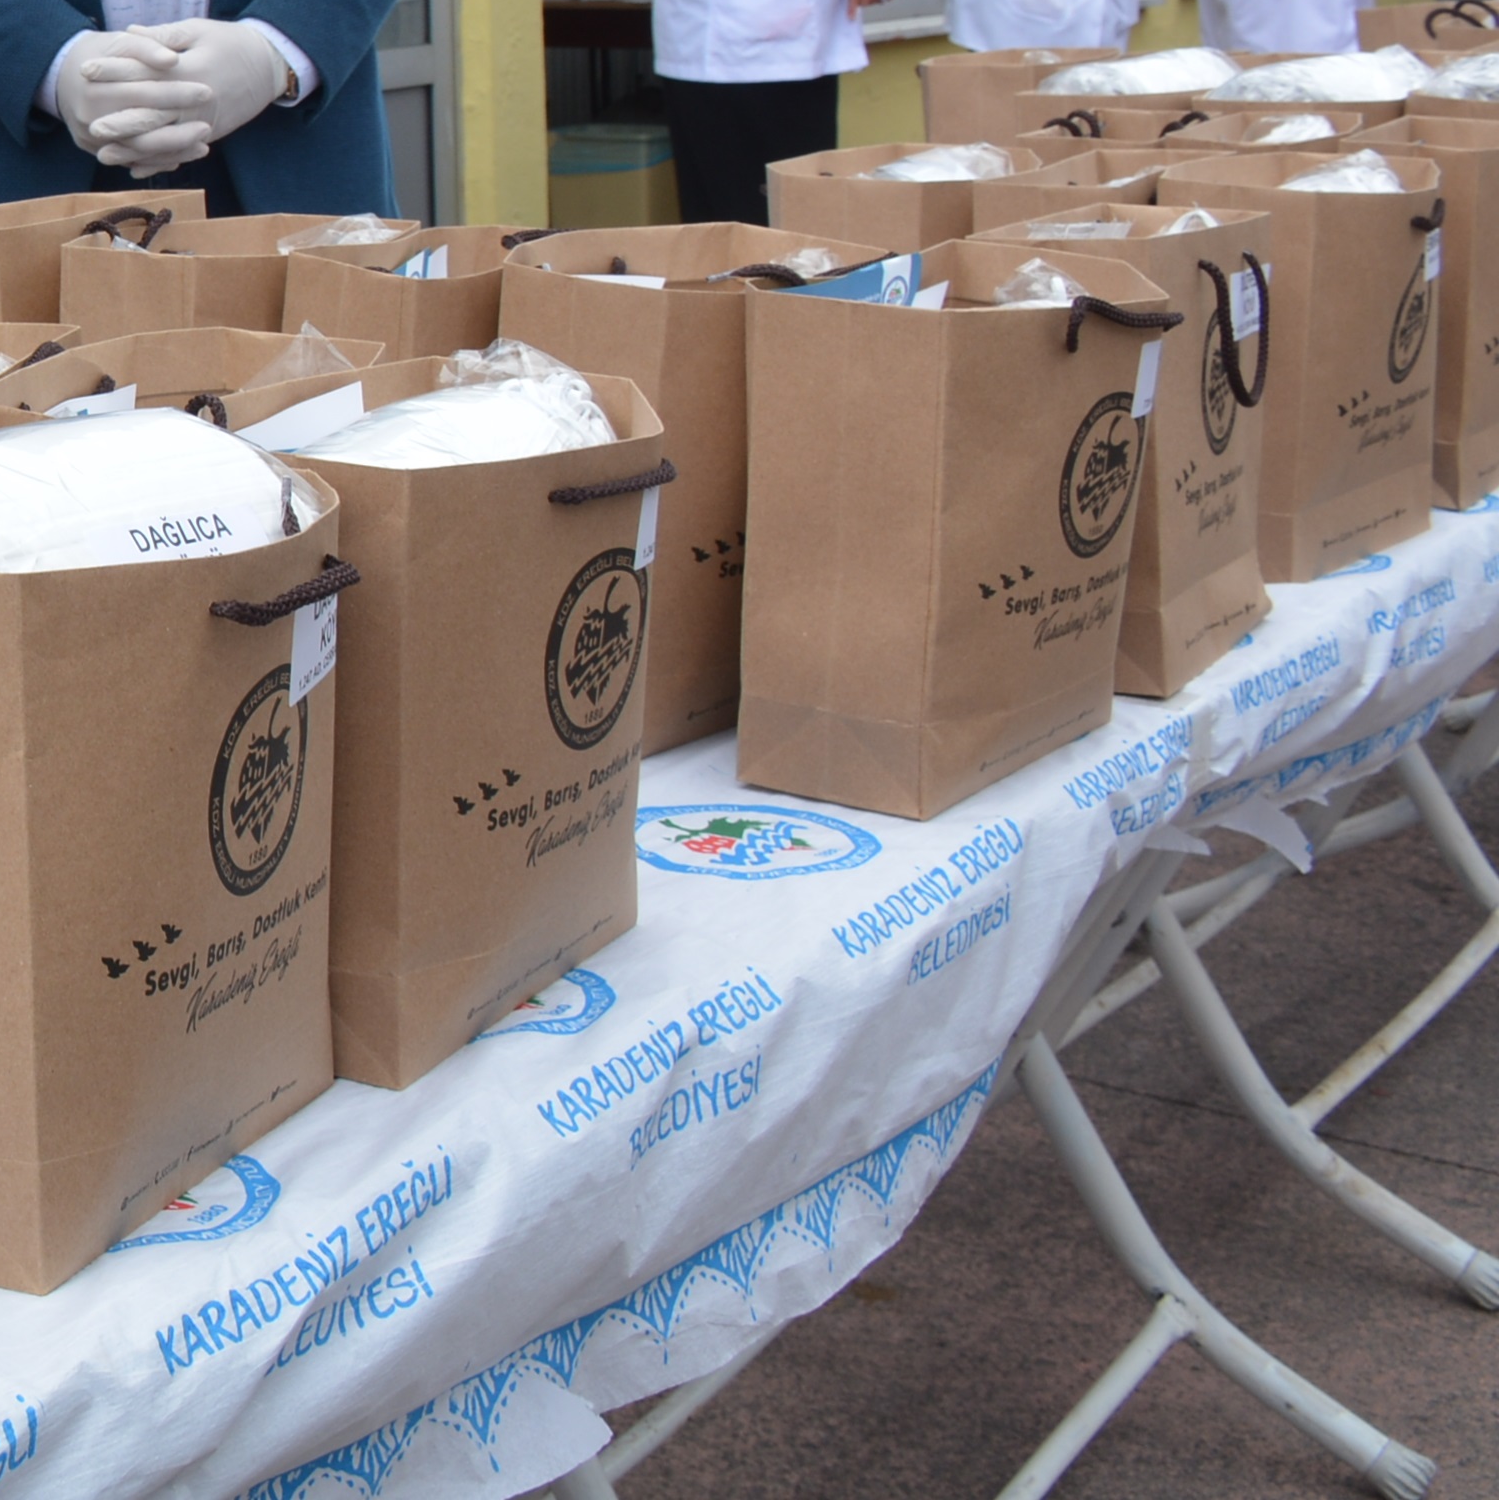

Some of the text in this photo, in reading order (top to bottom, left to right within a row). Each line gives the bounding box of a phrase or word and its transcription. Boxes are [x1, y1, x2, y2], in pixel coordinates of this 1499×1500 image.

[128, 512, 233, 553] DAĞLICA
[486, 795, 538, 831] Sevgi,
[543, 781, 583, 812] Barış,
[1062, 738, 1160, 810] KARADENİZ
[144, 952, 200, 997] Sevgi,
[206, 930, 247, 969] Barış,
[252, 887, 301, 941] Dostluk
[831, 864, 963, 959] KARADENİZ
[947, 817, 1024, 885] EREĞLİ
[906, 882, 1011, 987] BELEDİYESİ
[536, 1019, 691, 1138] KARADENİZ
[687, 965, 783, 1046] EREĞLİ
[628, 1043, 762, 1172] BELEDİYESİ
[155, 1224, 360, 1377] KARADENİZ
[355, 1143, 453, 1257] EREĞLİ
